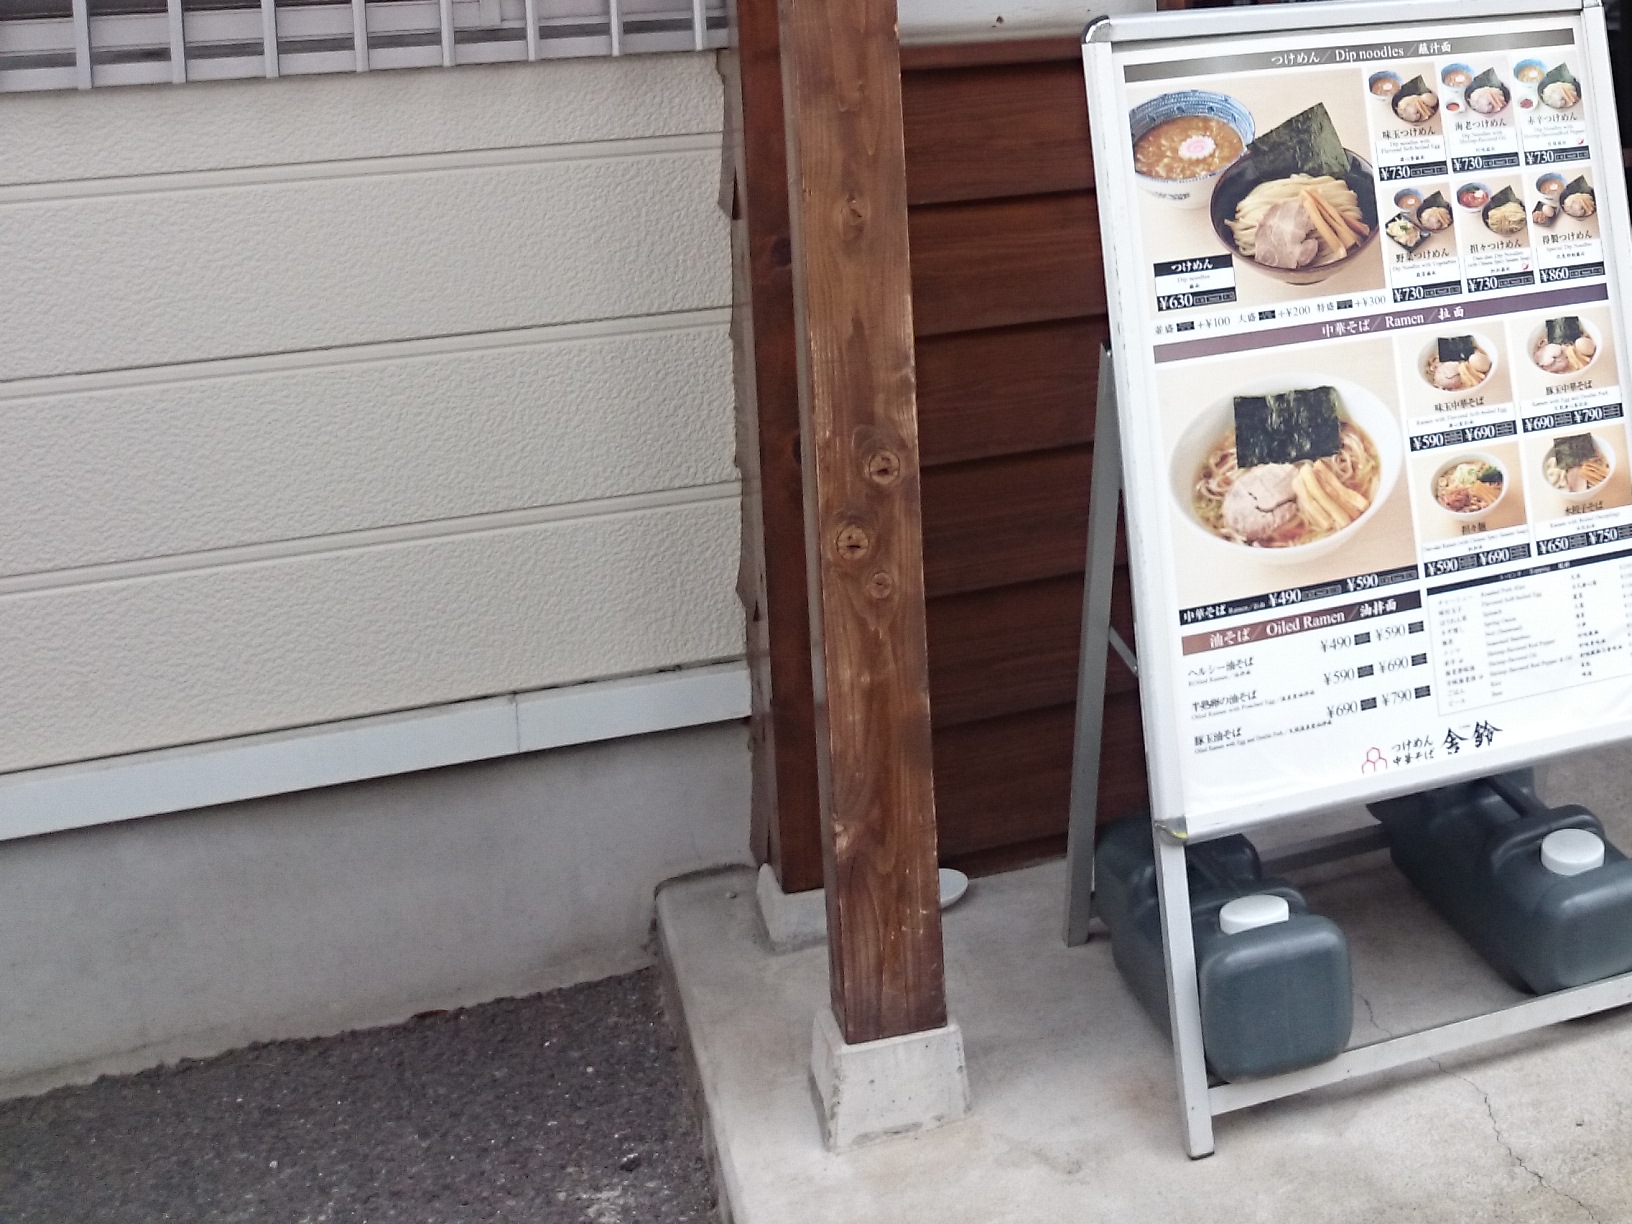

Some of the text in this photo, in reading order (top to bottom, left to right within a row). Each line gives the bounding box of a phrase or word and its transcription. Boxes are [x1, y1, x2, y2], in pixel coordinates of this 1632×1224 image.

[1271, 51, 1320, 66] つけめん
[1335, 48, 1357, 63] Dip
[1359, 45, 1405, 60] noodles
[1382, 126, 1436, 140] 味玉つけめん
[1453, 156, 1483, 171] ¥730
[1526, 150, 1554, 165] ¥730
[1381, 165, 1411, 180] ¥730
[1395, 248, 1449, 263] 野菜つけめん
[1171, 258, 1213, 273] つけめん
[1541, 267, 1569, 282] ¥860
[1469, 276, 1498, 292] ¥730
[1159, 293, 1193, 310] ¥630
[1395, 287, 1424, 302] ¥730
[1322, 318, 1370, 338] 中華そば
[1385, 313, 1425, 328] Ramen
[1525, 408, 1603, 431] ¥690 ¥790
[1413, 425, 1496, 450] ¥590 ¥690
[1539, 537, 1569, 553] ¥650
[1589, 528, 1618, 544] ¥750
[1428, 549, 1510, 575] ¥590 ¥690
[1183, 603, 1227, 622] 中華そば
[1268, 588, 1301, 607] ¥490
[1346, 573, 1379, 592] ¥590
[1210, 627, 1251, 649] 油そば
[1266, 617, 1300, 636] Oiled
[1303, 610, 1345, 630] Ramen
[1320, 624, 1406, 653] ¥490 ¥590
[1323, 656, 1409, 686] ¥590 ¥690
[1326, 689, 1412, 719] ¥690 ¥790
[1391, 735, 1434, 752] つけめん
